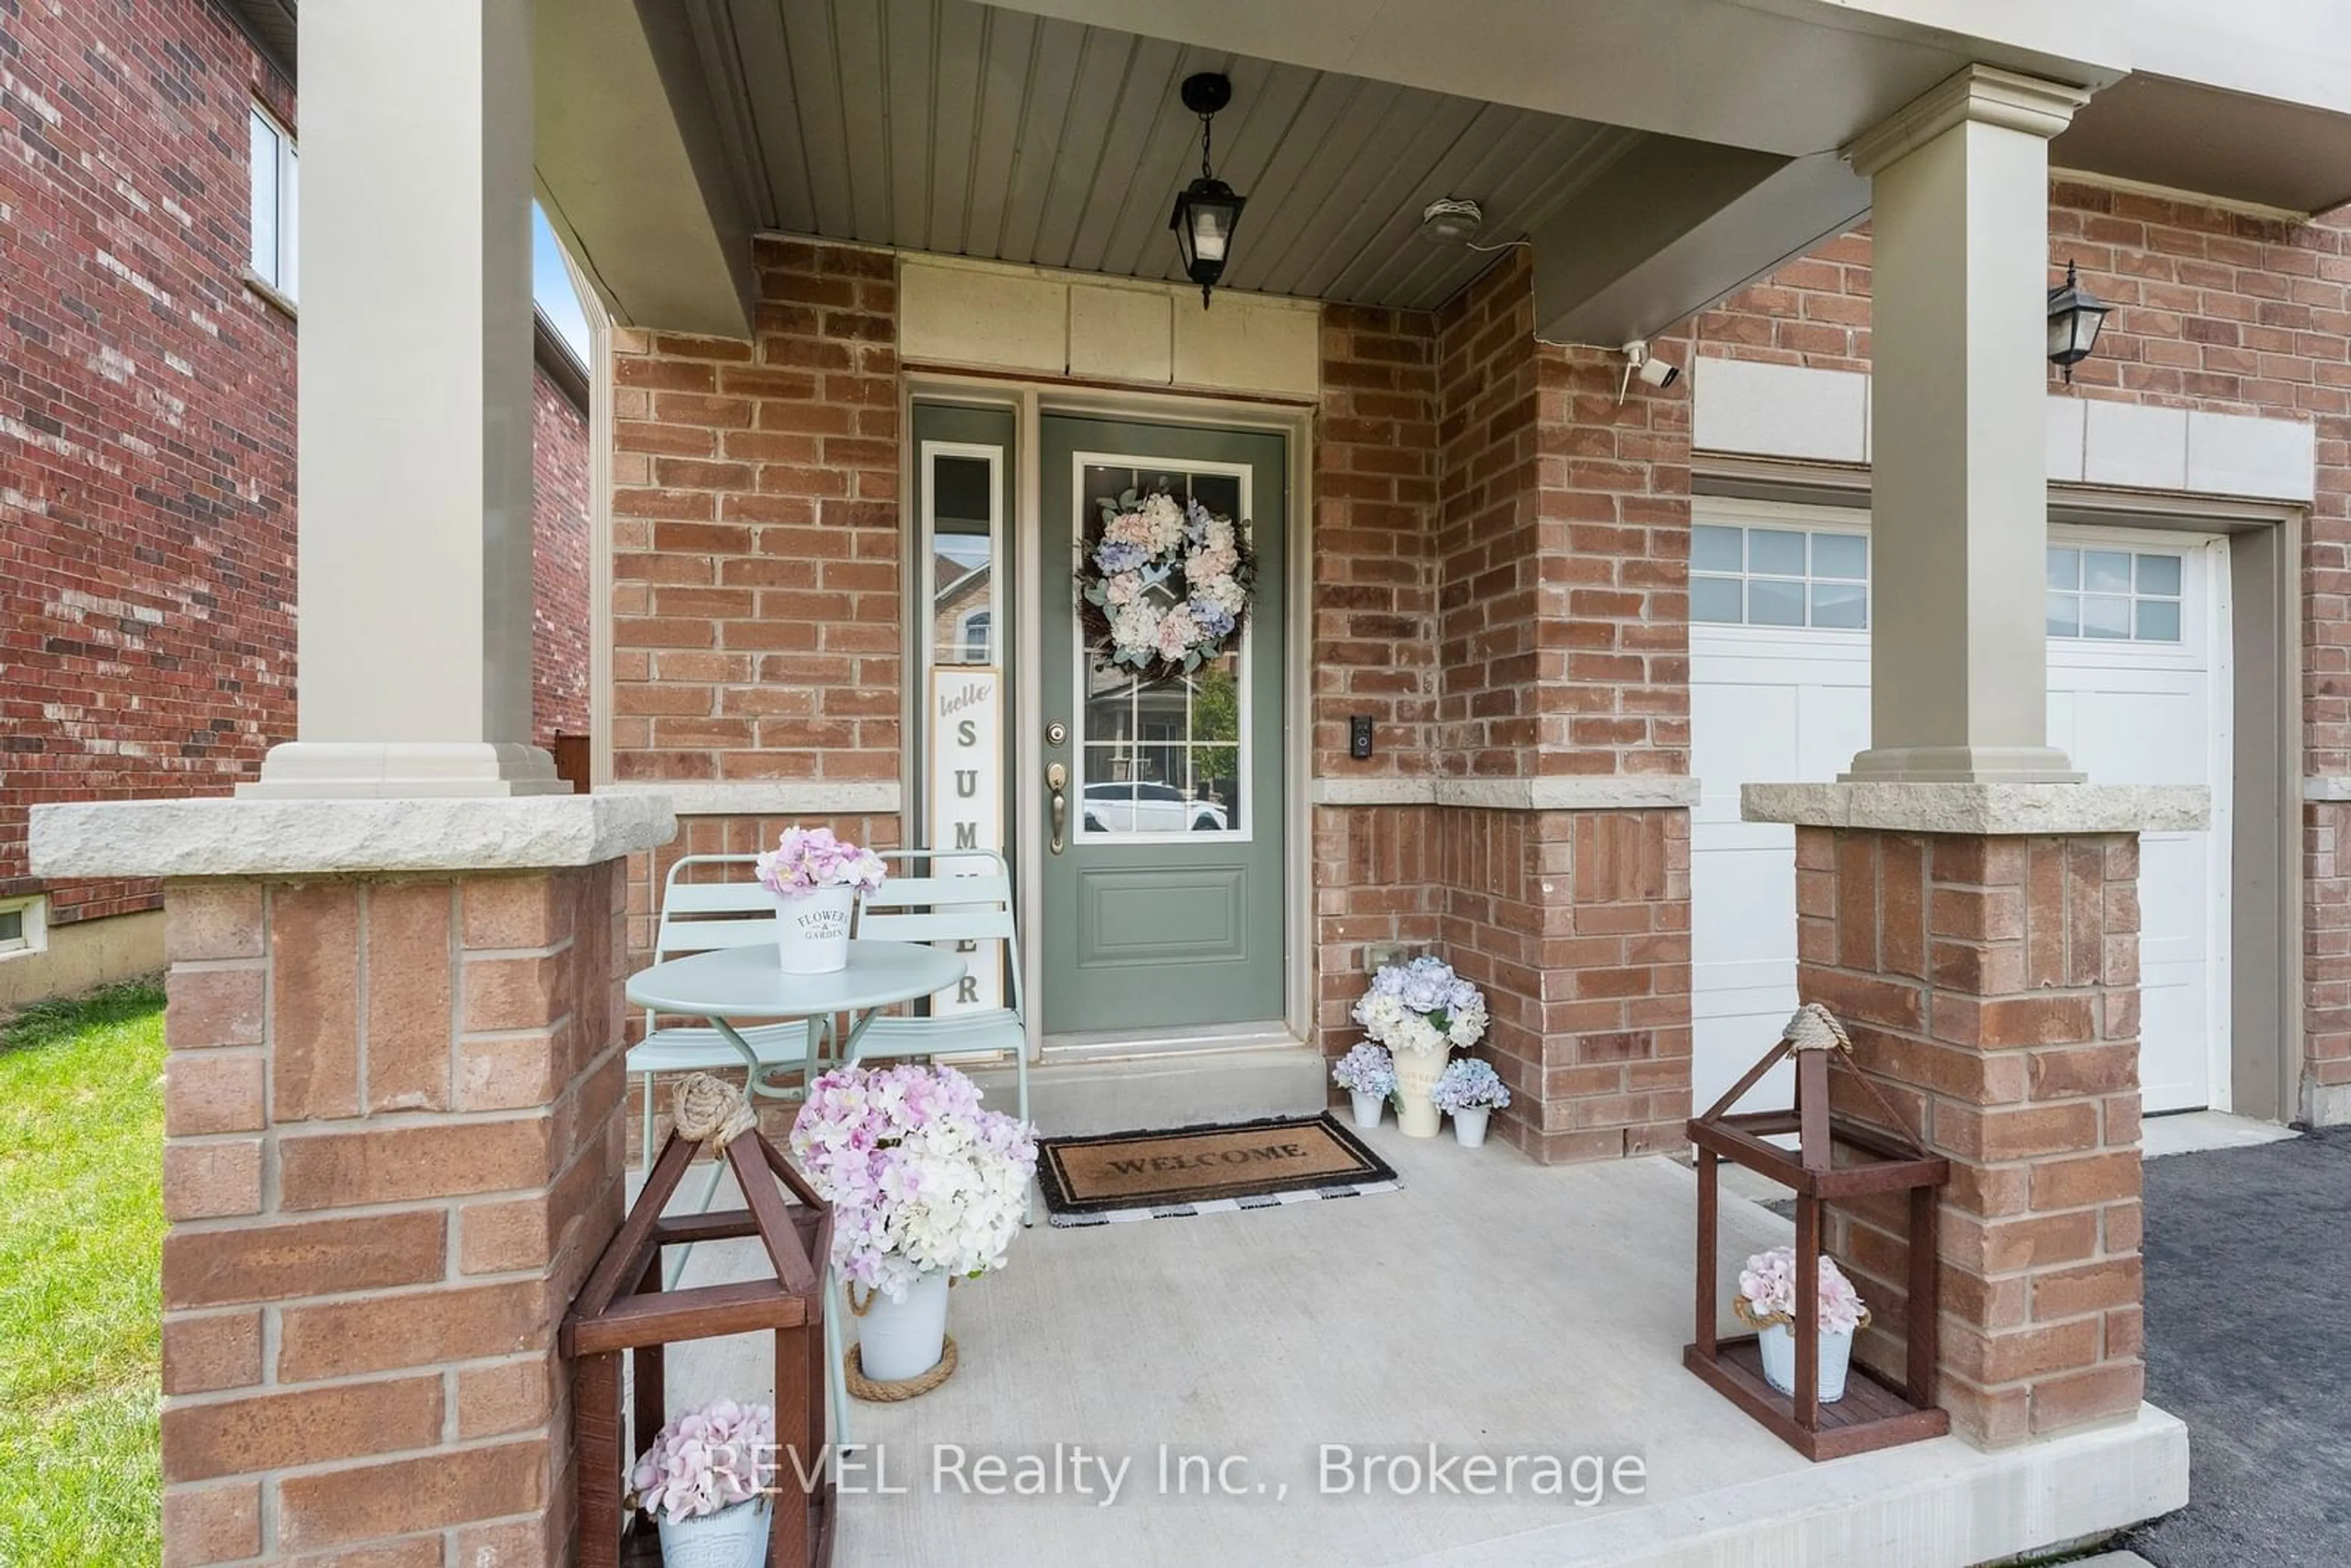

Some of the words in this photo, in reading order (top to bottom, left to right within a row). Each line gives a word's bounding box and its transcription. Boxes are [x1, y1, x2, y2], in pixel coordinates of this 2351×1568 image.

[940, 683, 991, 717] hello
[955, 719, 979, 1003] SUMER
[804, 928, 844, 939] GARDEN
[1106, 1144, 1308, 1175] WELCOME
